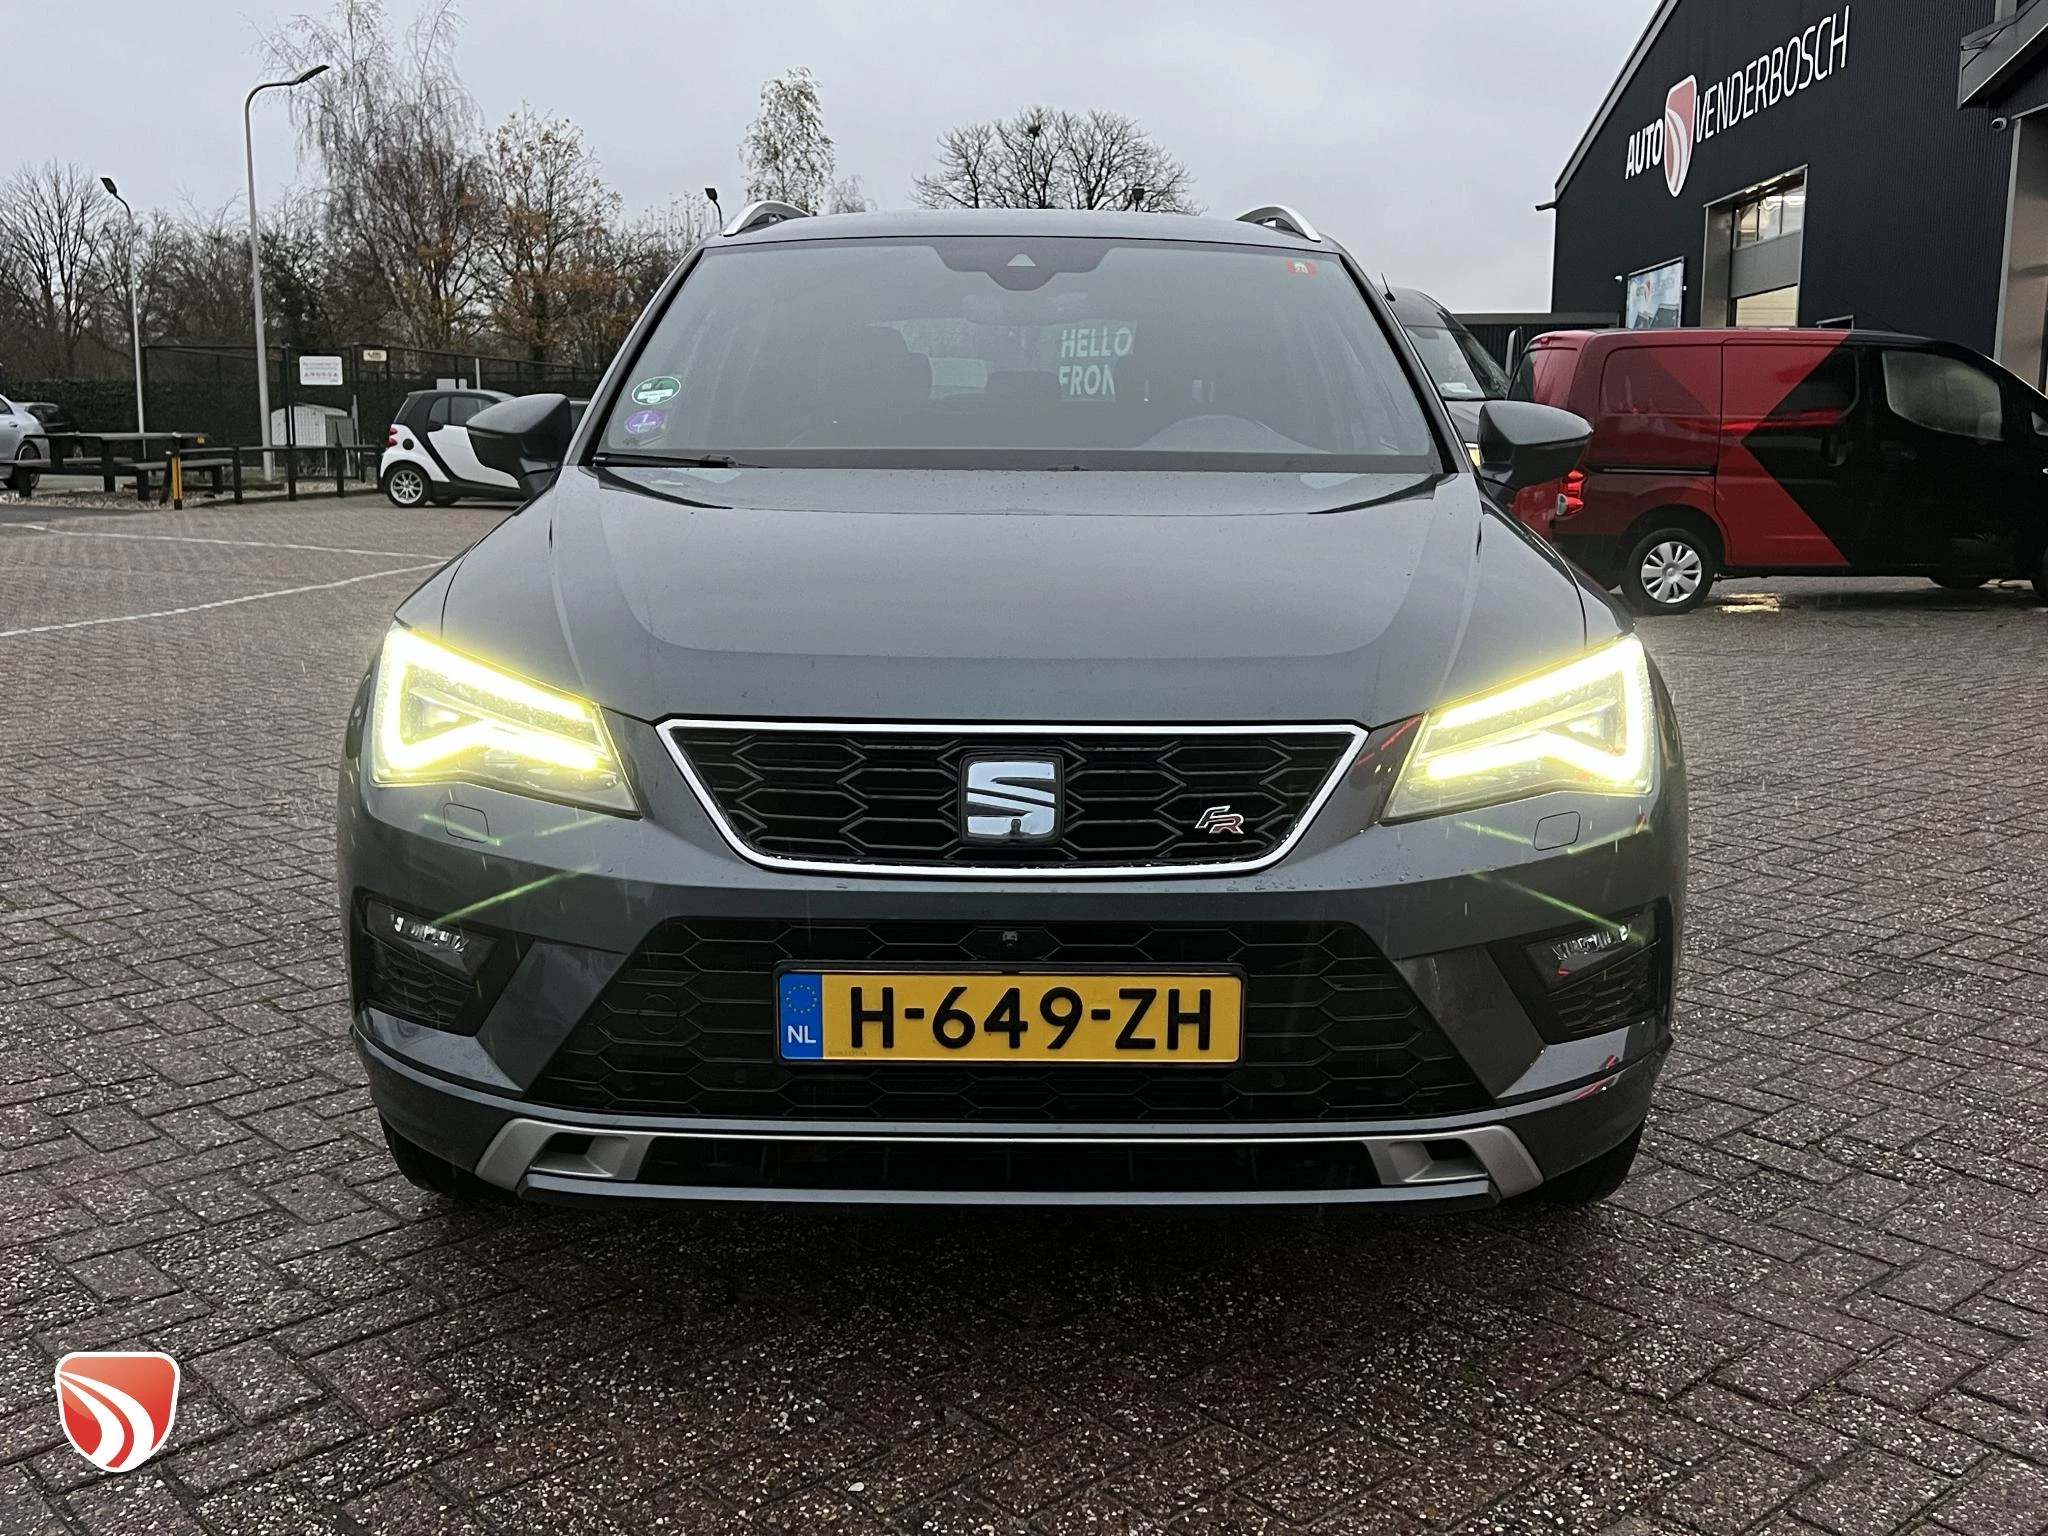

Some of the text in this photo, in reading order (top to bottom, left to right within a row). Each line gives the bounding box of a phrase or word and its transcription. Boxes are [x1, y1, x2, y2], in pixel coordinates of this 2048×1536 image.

[1624, 4, 1850, 180] AUTO VENDERBOSCH
[1061, 327, 1132, 358] HELLO
[1195, 805, 1244, 834] FR
[850, 986, 1212, 1050] H-649-ZH
[787, 1025, 817, 1044] NL
